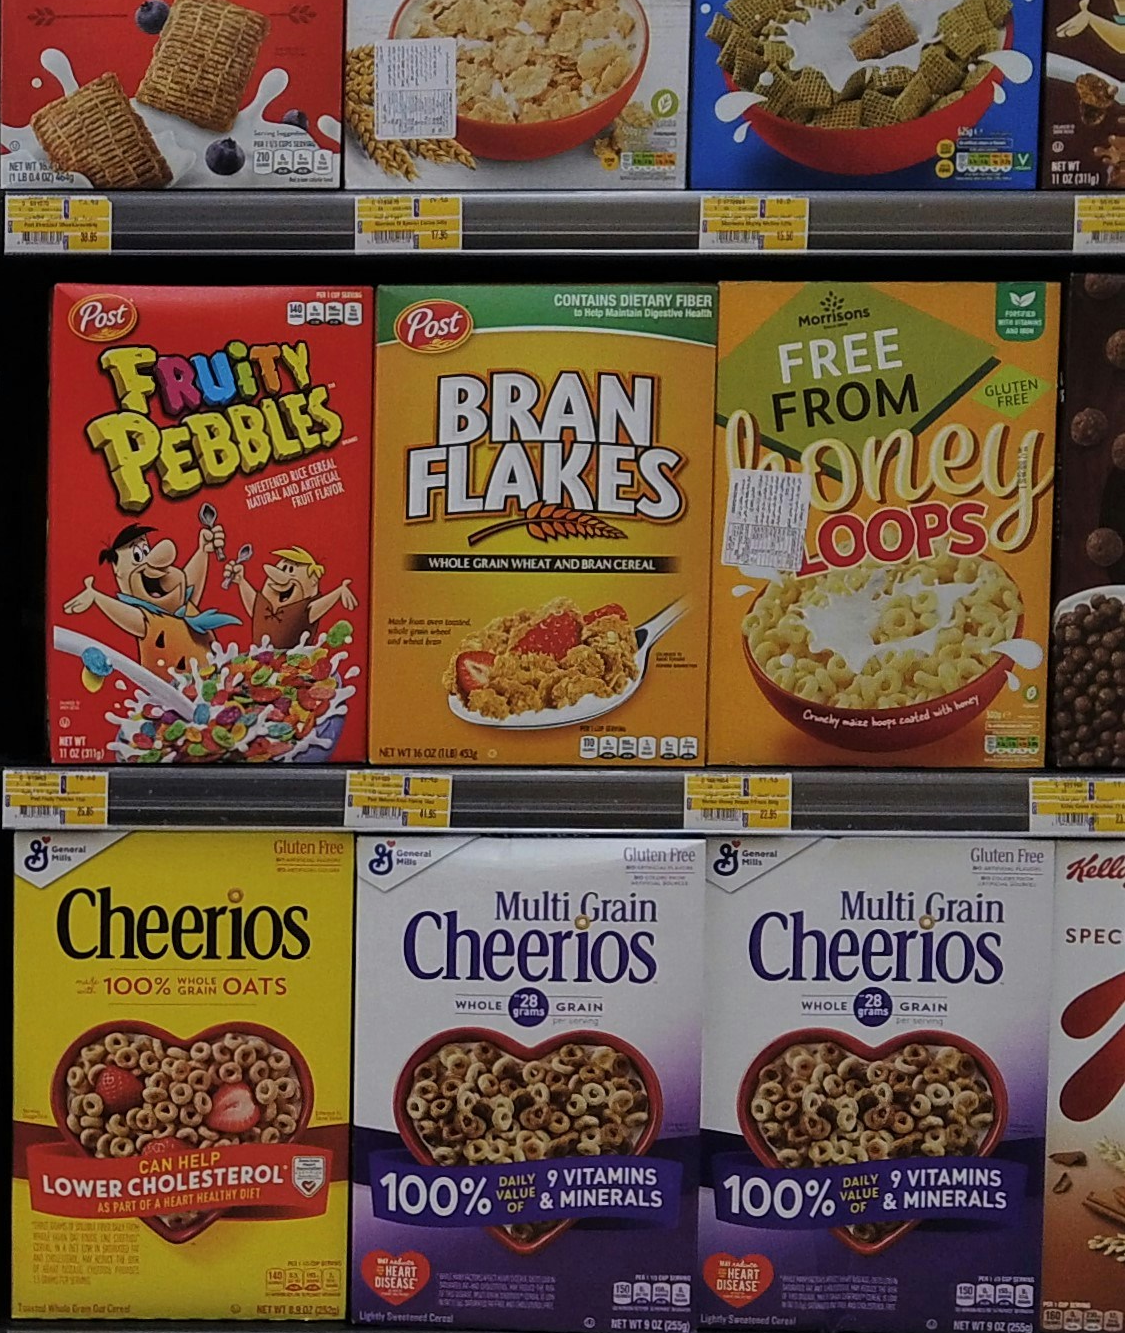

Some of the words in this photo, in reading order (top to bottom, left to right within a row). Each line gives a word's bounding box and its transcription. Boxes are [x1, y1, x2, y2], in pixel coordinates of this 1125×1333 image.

[554, 294, 617, 308] CONTAINS
[619, 293, 672, 308] DIETARY
[674, 294, 713, 308] FIBER
[778, 328, 903, 384] FREE
[101, 340, 309, 415] FRUITY
[984, 378, 1039, 396] GLUTEN
[438, 371, 654, 448] BRAN
[772, 373, 919, 432] FROM
[997, 391, 1029, 408] FREE
[86, 385, 344, 514] PEBBLES
[407, 441, 682, 519] FLAKES
[803, 708, 839, 729] Crunchy
[842, 717, 869, 728] maize
[871, 716, 897, 730] hoops
[898, 711, 930, 725] coated
[932, 703, 952, 719] with
[953, 695, 980, 717] honey
[274, 840, 312, 855] Gluten
[313, 840, 344, 855] Free
[57, 886, 311, 961] Cheerios
[495, 890, 570, 922] Multi
[581, 893, 657, 923] Grain
[403, 910, 656, 983] Cheerios
[103, 977, 171, 996] 100%
[223, 977, 287, 995] OATS
[138, 1158, 173, 1174] CAN
[178, 1151, 220, 1169] HELP
[42, 1174, 124, 1200] LOWER
[127, 1166, 284, 1197] CHOLESTEROL
[380, 1170, 492, 1217] 100%
[563, 1167, 658, 1186] VITAMINS
[559, 1188, 663, 1209] MINERALS
